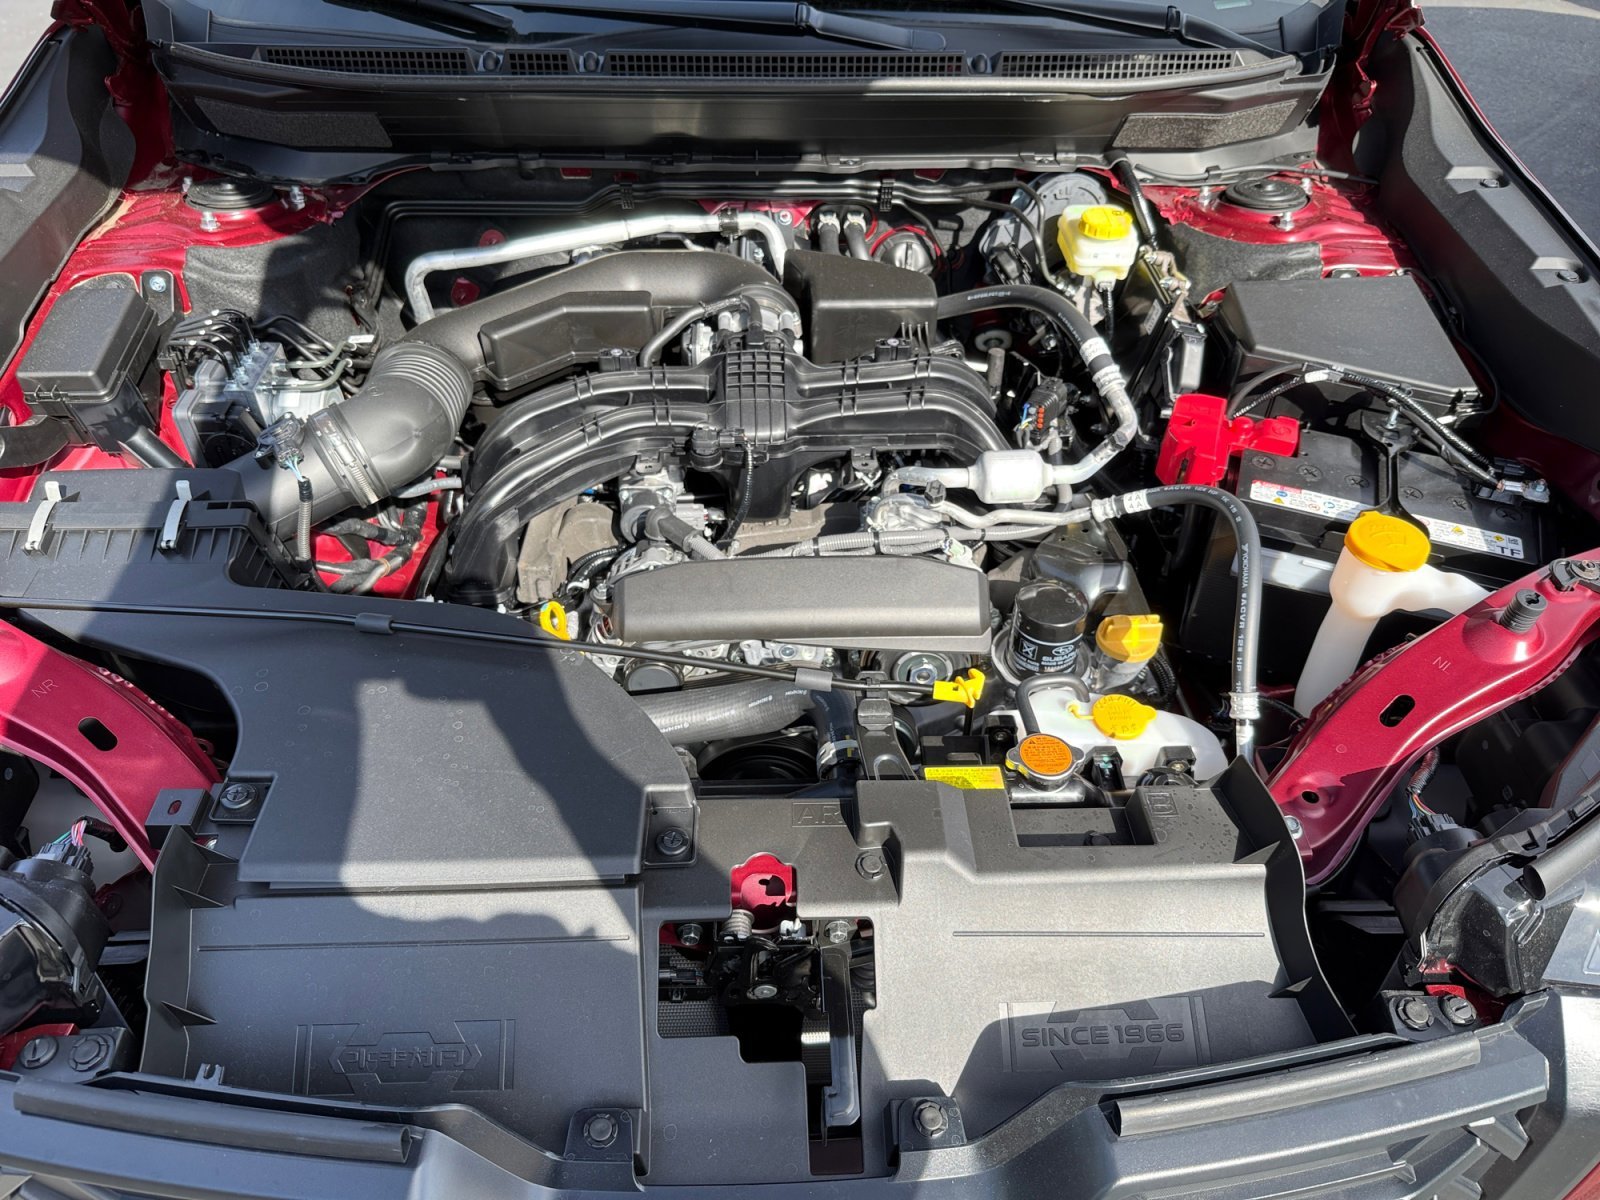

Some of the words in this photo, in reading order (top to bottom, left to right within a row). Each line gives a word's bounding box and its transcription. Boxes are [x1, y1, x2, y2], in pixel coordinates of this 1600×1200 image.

[1496, 545, 1521, 557] TF
[1241, 545, 1249, 588] YOKOHAMA
[1236, 657, 1243, 672] HP
[1432, 656, 1451, 675] NL
[31, 679, 58, 699] NR
[1021, 1025, 1110, 1047] SINCE
[1114, 1022, 1185, 1044] 1966
